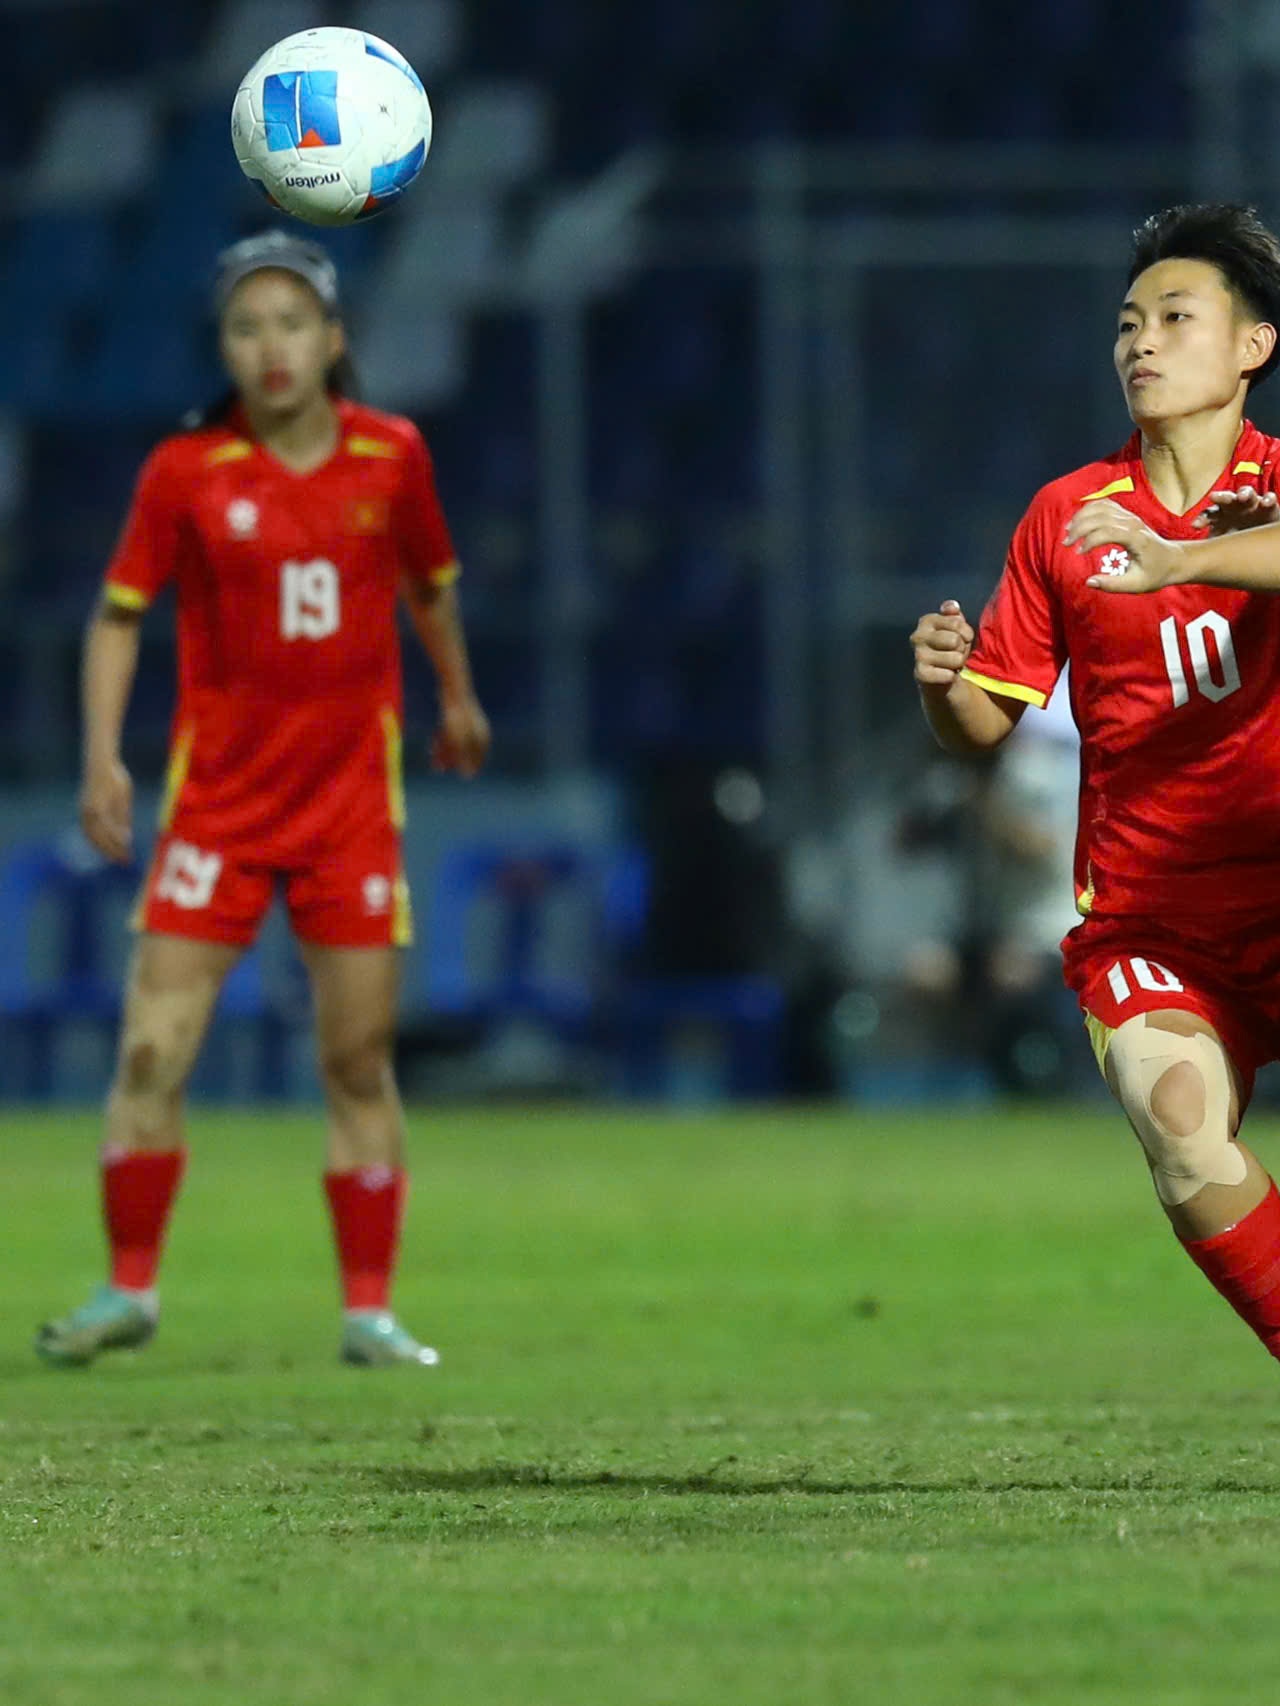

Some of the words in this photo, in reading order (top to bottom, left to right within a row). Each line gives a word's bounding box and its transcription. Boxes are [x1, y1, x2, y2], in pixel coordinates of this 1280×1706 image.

[285, 172, 341, 189] molten
[281, 559, 340, 640] 19
[1159, 609, 1242, 709] 10
[157, 840, 222, 908] 19
[1107, 956, 1184, 1005] 10
